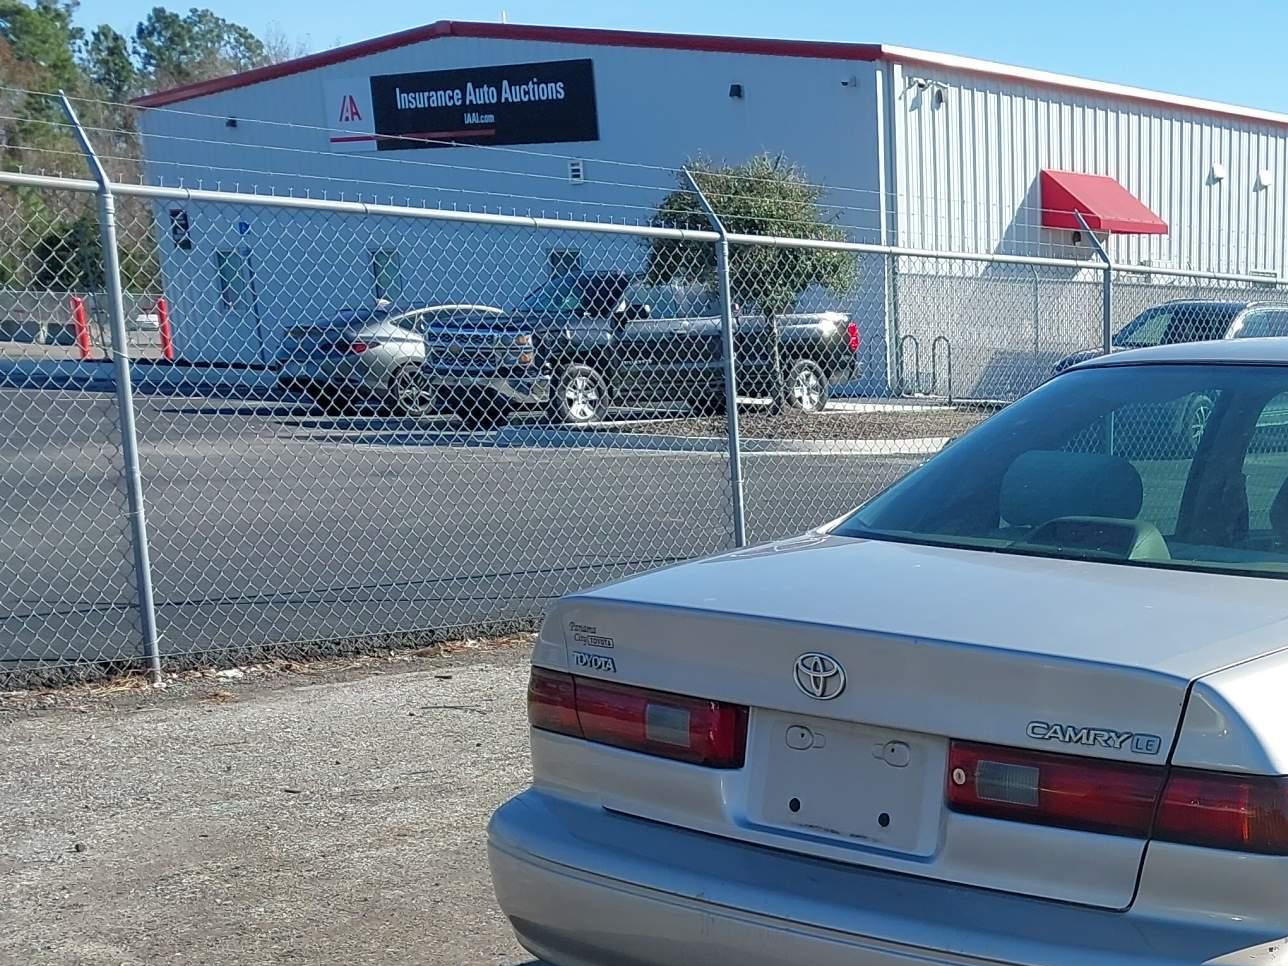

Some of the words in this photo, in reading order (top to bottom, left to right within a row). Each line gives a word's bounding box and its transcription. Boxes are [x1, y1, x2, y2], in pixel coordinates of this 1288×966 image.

[395, 87, 462, 110] Insurance
[465, 81, 498, 105] Auto
[501, 77, 566, 103] Auctions
[463, 112, 496, 124] IAAI.com
[572, 651, 617, 673] TOYOTA
[1026, 721, 1132, 749] CAMRY
[1134, 736, 1157, 752] LE
